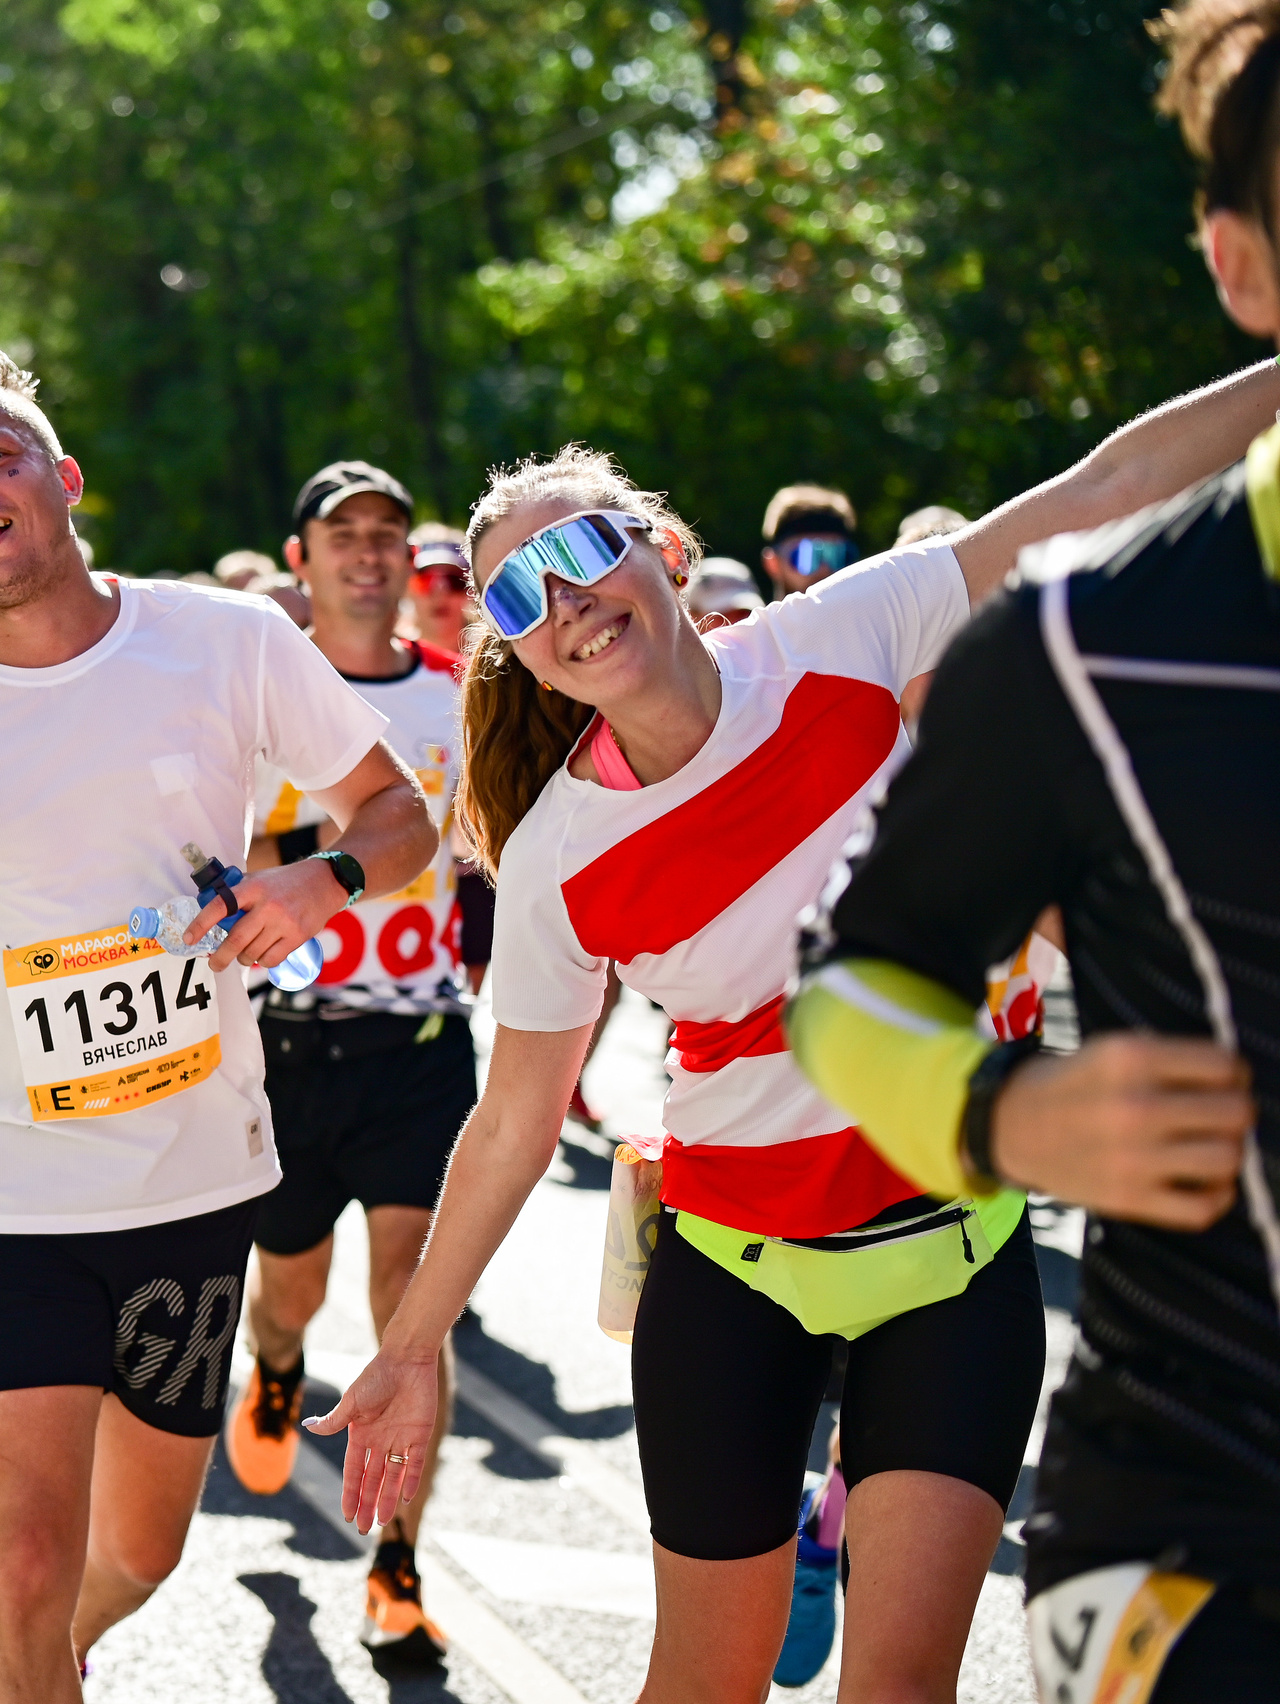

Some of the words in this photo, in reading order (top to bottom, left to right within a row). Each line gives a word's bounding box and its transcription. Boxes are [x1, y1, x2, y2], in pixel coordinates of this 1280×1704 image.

[63, 946, 129, 970] МОСКВА
[24, 957, 212, 1053] 11314
[82, 1031, 168, 1066] ВЯЧЕСЛАВ
